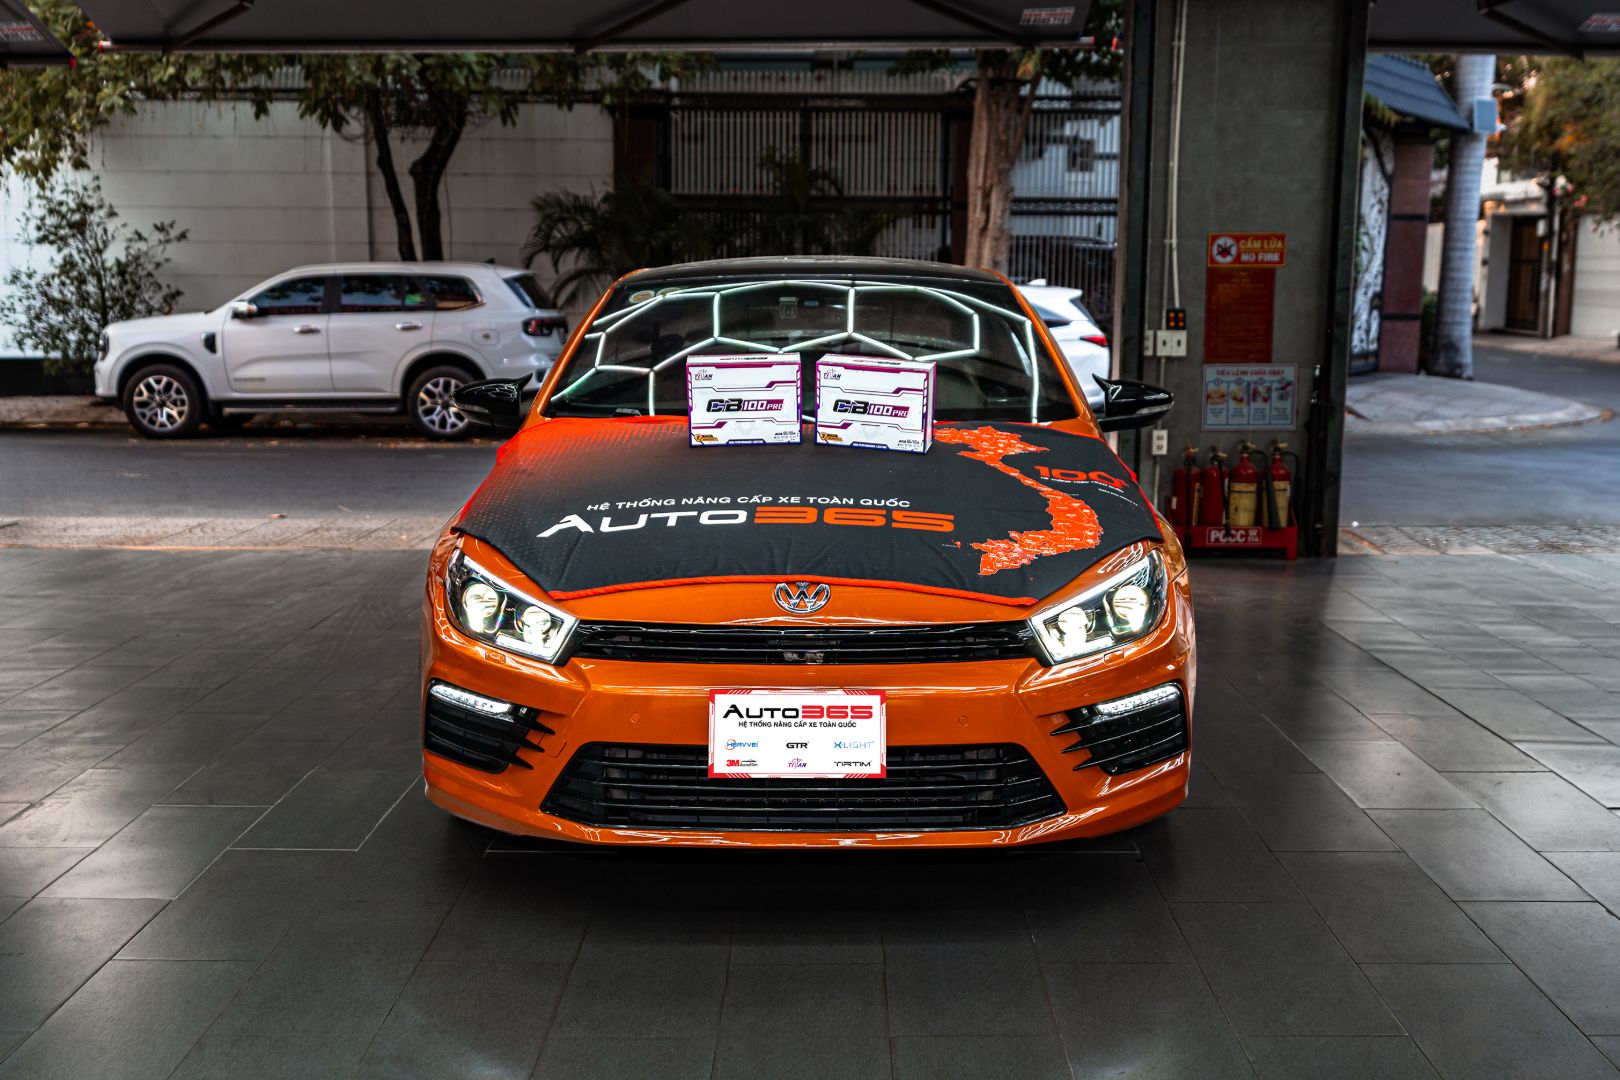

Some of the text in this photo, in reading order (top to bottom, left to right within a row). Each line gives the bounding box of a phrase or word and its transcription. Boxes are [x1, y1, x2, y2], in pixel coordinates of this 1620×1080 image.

[1239, 236, 1283, 249] CẤM LỬA
[1240, 252, 1280, 262] NO FIRE
[586, 494, 911, 511] HỆ THỐNG NÂNG CẤP XE TOÀN QUỐC
[738, 720, 748, 729] HỆ
[749, 719, 772, 728] THỐNG
[773, 720, 793, 728] NÂNG
[793, 719, 808, 728] CẤP
[819, 720, 837, 728] TOÀN
[837, 719, 857, 728] QUỐC
[726, 759, 740, 767] 3M
